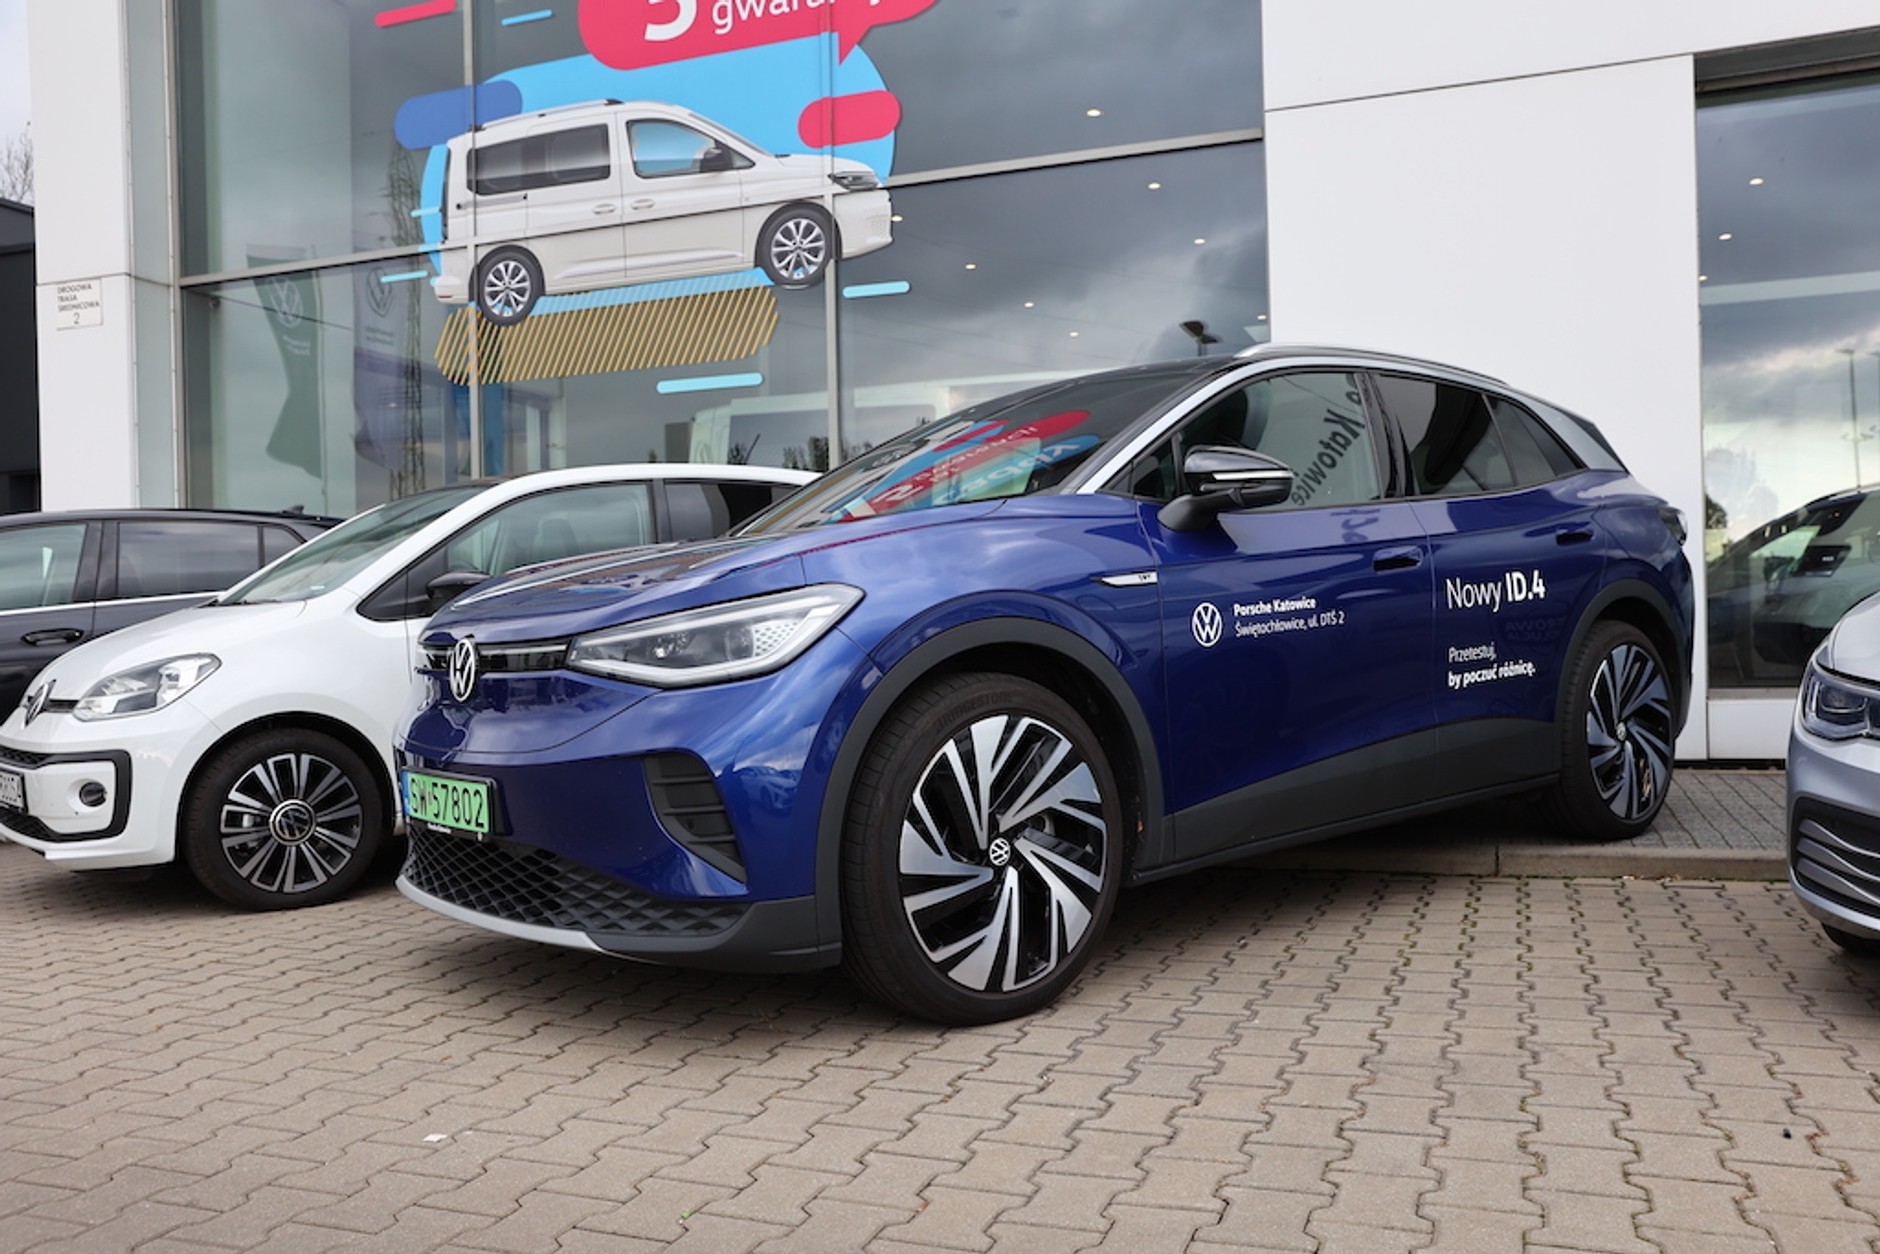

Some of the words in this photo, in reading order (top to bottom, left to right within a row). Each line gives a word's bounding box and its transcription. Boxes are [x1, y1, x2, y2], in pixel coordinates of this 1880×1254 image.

[73, 312, 80, 325] 2
[1446, 577, 1501, 612] Nowy
[1505, 569, 1545, 602] ID.4
[1233, 601, 1272, 616] Porsche
[1273, 596, 1316, 612] Katowice
[1338, 611, 1345, 624] 2
[1448, 671, 1462, 689] by
